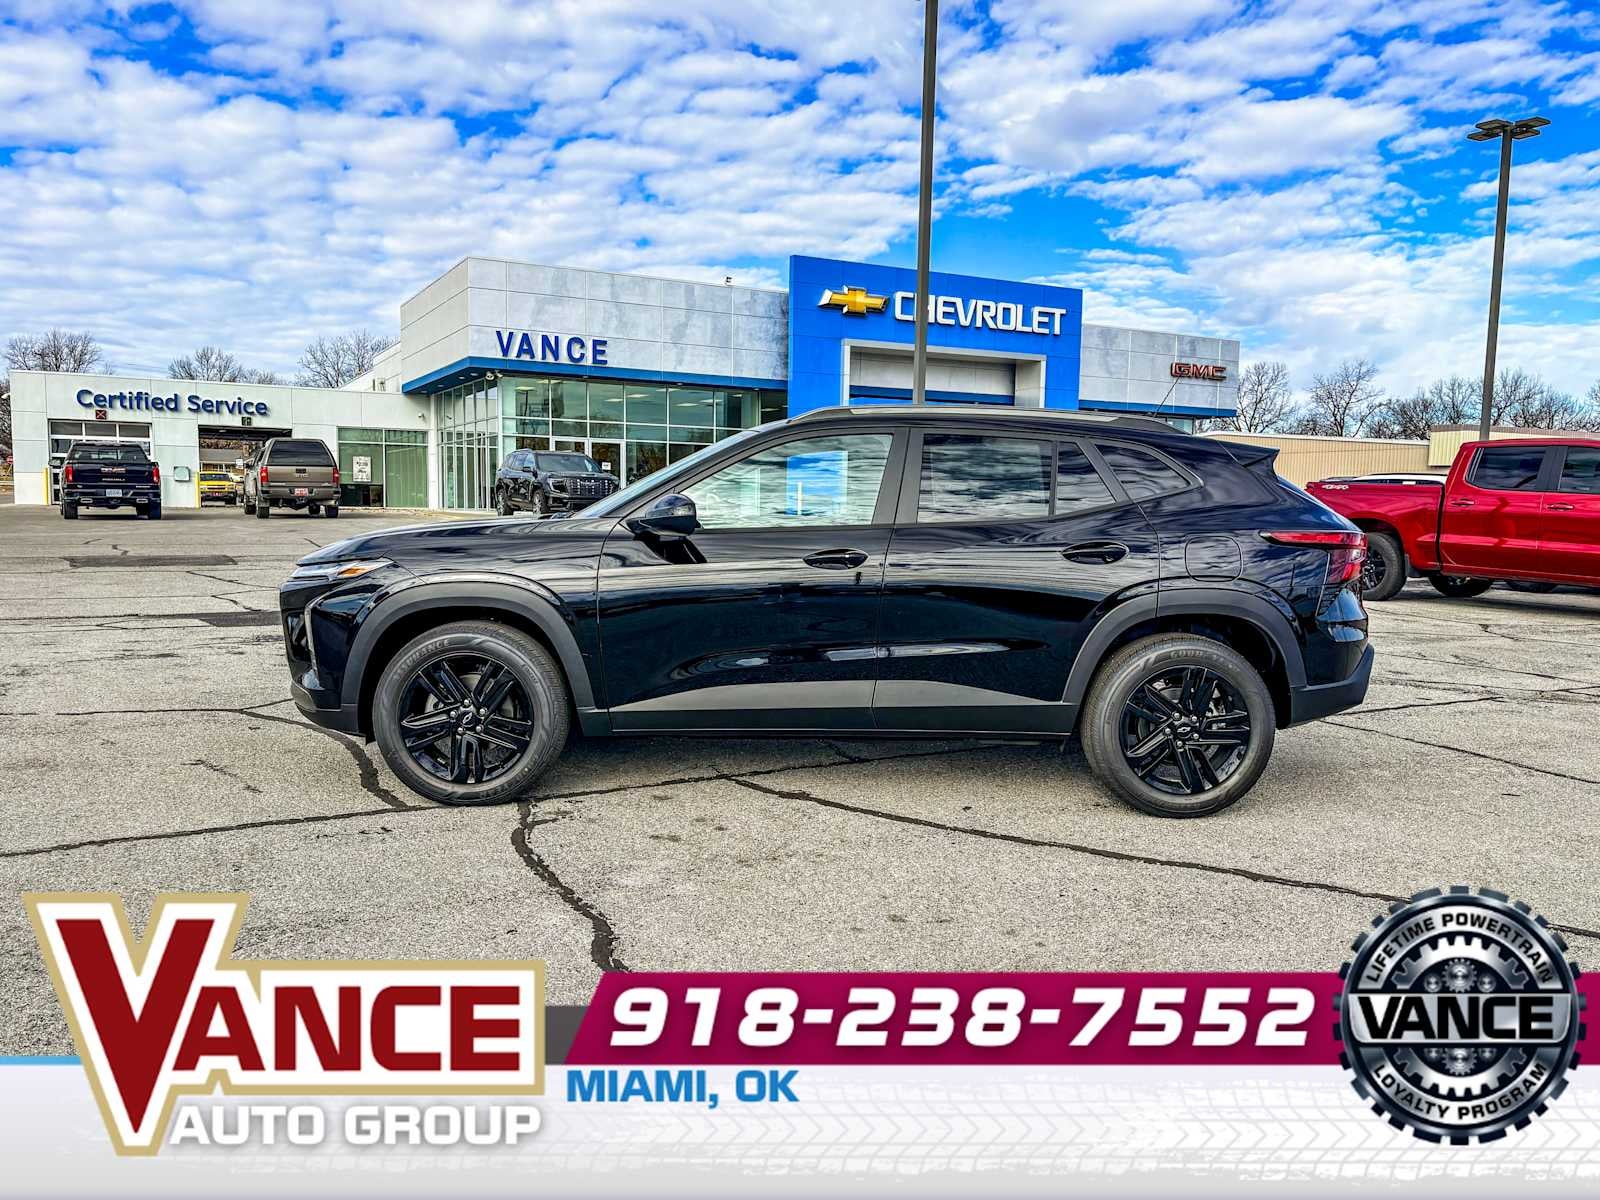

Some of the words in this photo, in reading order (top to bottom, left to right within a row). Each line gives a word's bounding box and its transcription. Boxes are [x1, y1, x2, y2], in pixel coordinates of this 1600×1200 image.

[495, 330, 609, 366] VANCE
[1171, 362, 1227, 381] GMC
[76, 389, 179, 412] Certified
[187, 395, 268, 416] Service
